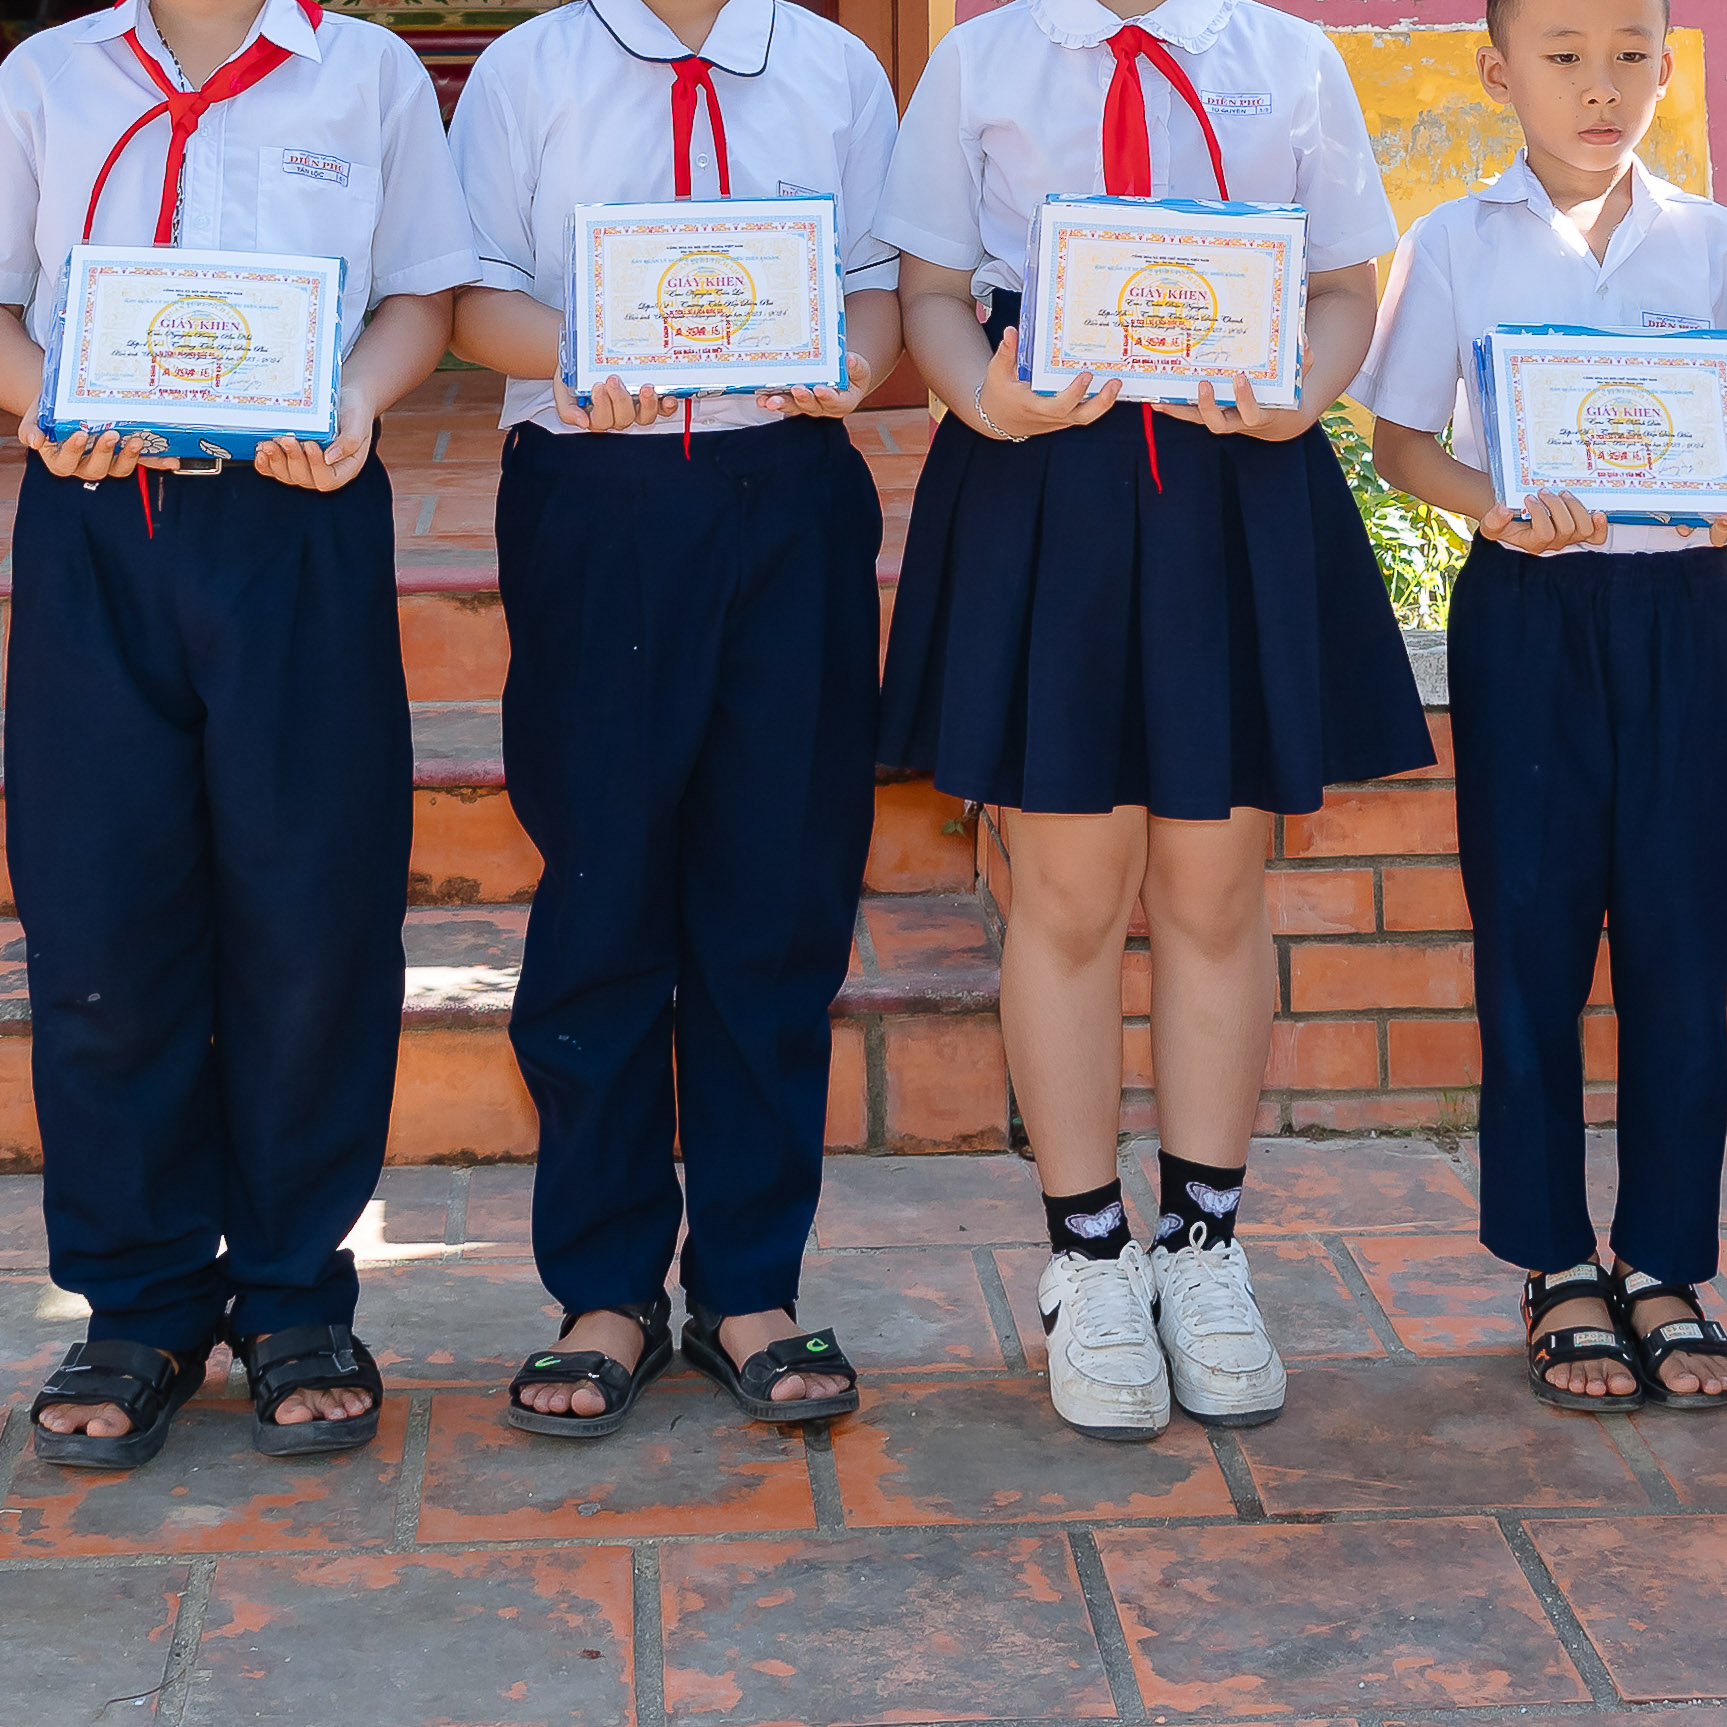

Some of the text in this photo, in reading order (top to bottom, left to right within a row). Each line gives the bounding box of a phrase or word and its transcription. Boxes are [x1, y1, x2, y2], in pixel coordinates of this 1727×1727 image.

[705, 275, 745, 287] KHEN
[1167, 288, 1207, 301] KHEN
[199, 319, 241, 332] KHEN
[1623, 406, 1662, 418] KHEN
